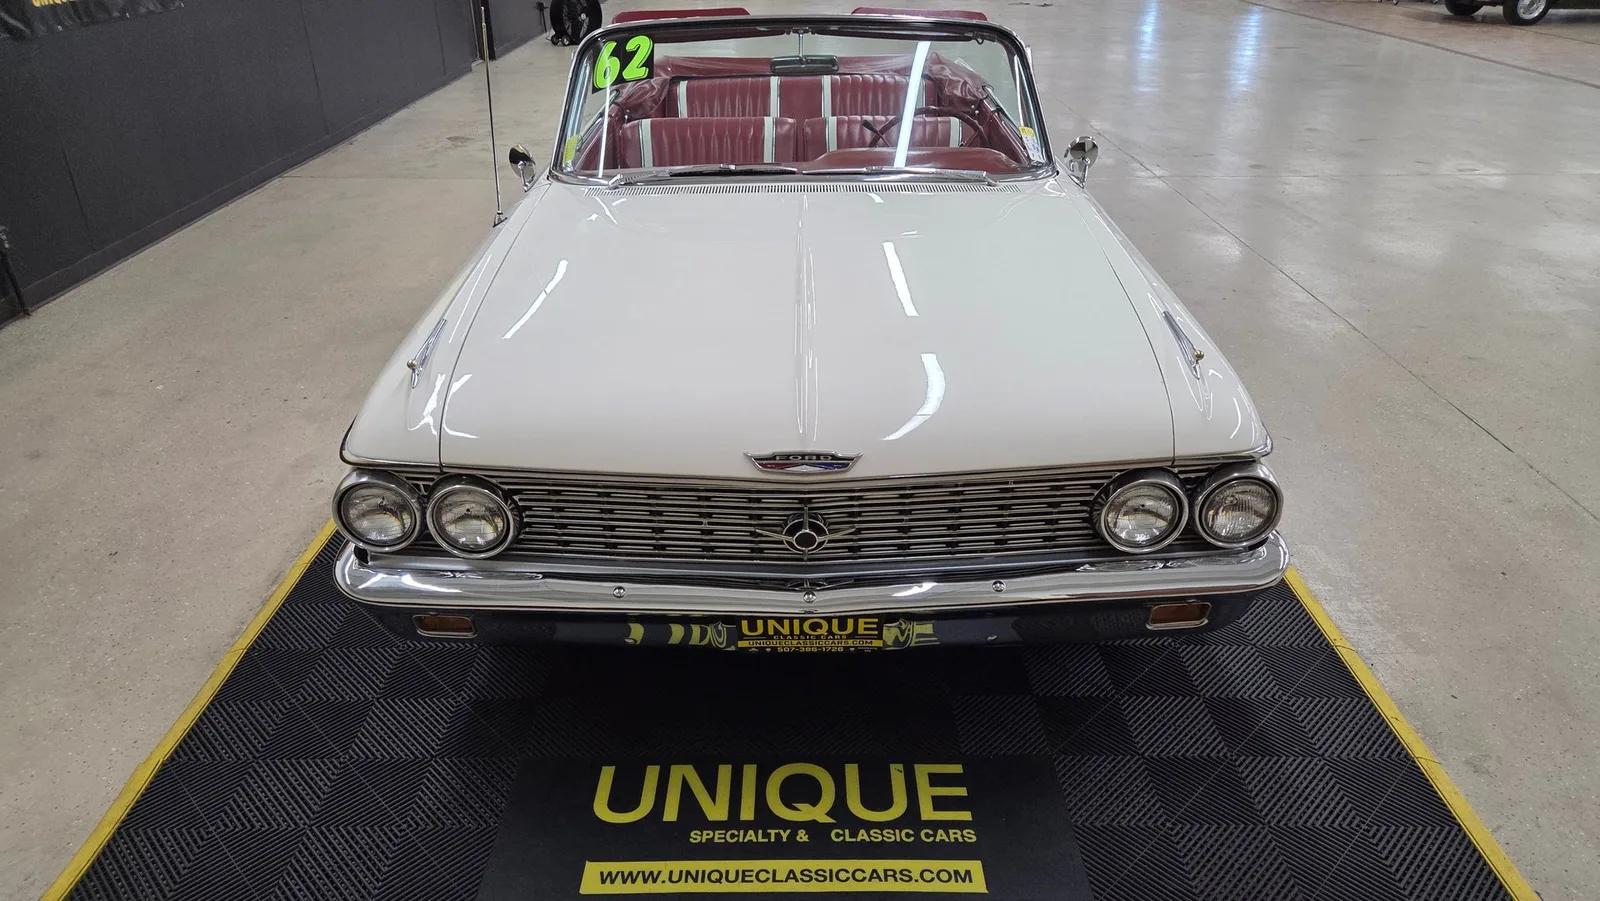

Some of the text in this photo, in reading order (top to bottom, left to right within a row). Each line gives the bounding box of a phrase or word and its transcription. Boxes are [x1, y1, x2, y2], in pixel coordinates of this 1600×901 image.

[594, 35, 653, 89] 62
[741, 618, 879, 635] UNIQUE
[593, 762, 973, 823] UNIQUE
[689, 829, 977, 843] SPECIALTY & CLASSIC CARS
[599, 868, 973, 885] WWW.UNIQUECLASSICCARS.COM
